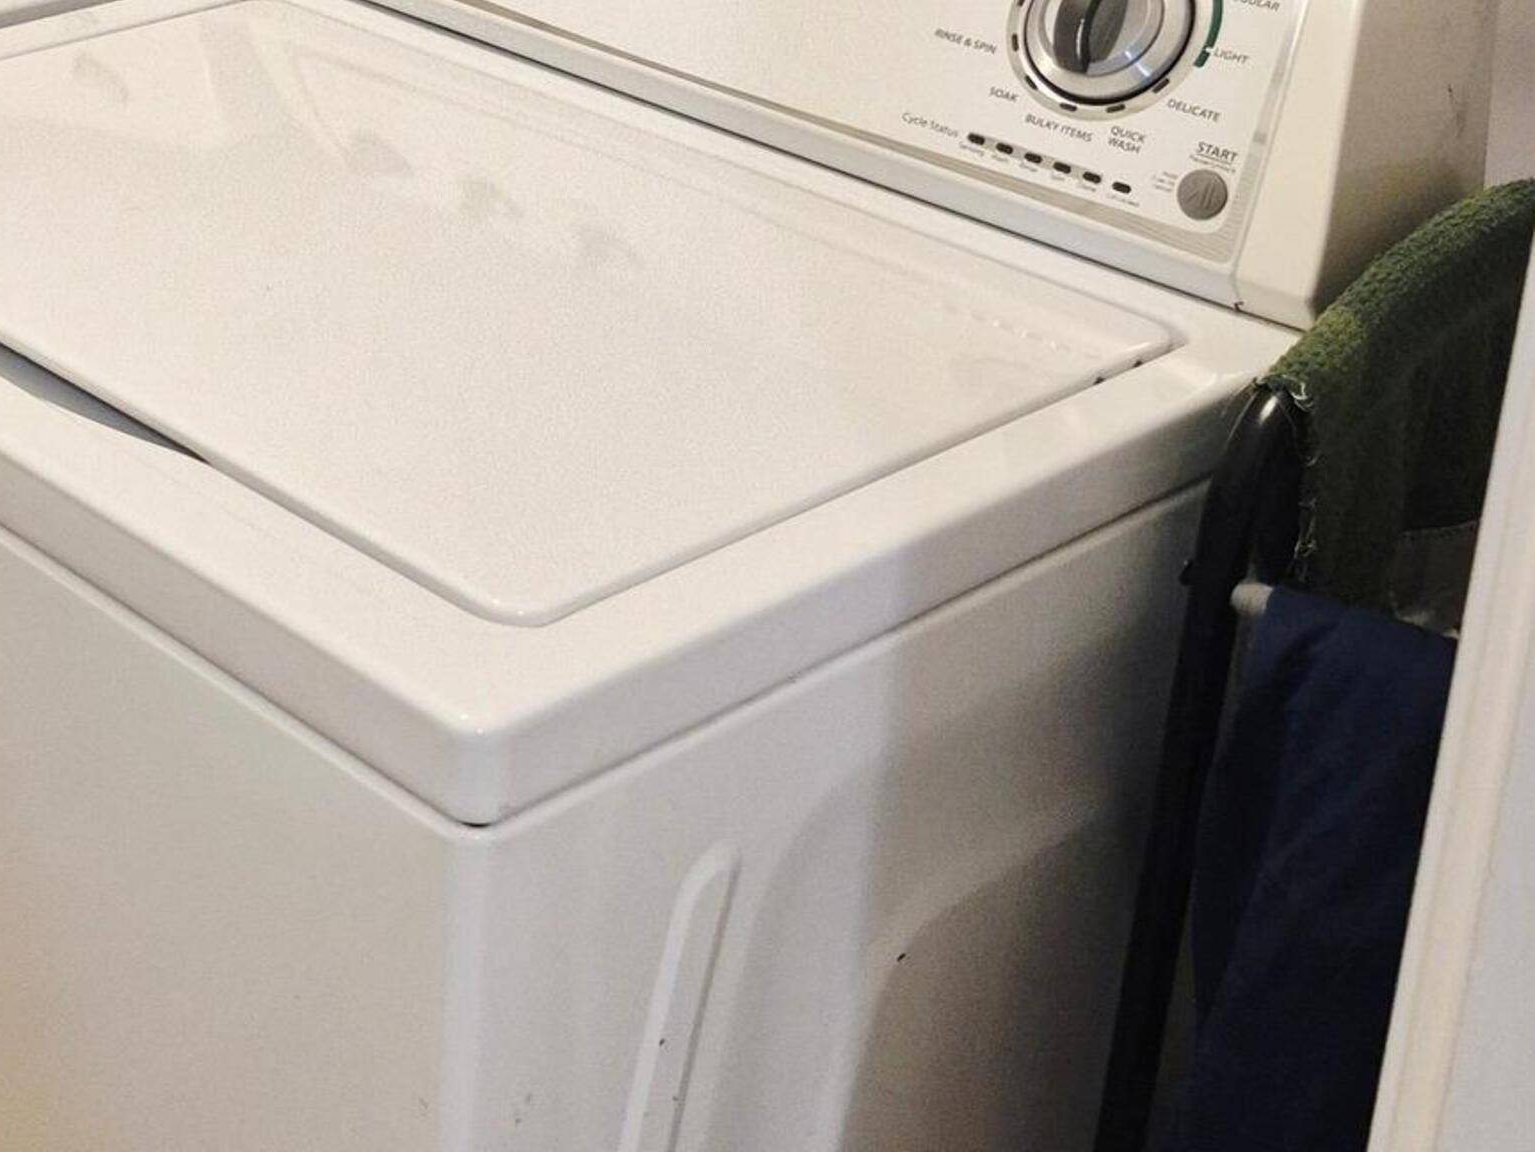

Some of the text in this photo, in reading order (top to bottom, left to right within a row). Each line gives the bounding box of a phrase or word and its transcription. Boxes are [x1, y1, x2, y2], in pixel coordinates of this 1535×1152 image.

[934, 28, 964, 45] RINSE
[974, 39, 998, 54] SPIN
[1213, 48, 1250, 64] LIGHT
[988, 86, 1019, 104] SOAK
[1166, 98, 1222, 123] DELICATE
[901, 112, 960, 140] Cycle Status
[1024, 113, 1094, 143] BULKY ITEMS
[1109, 125, 1147, 144] QUICK
[1107, 137, 1142, 155] WASH
[1196, 141, 1239, 162] START
